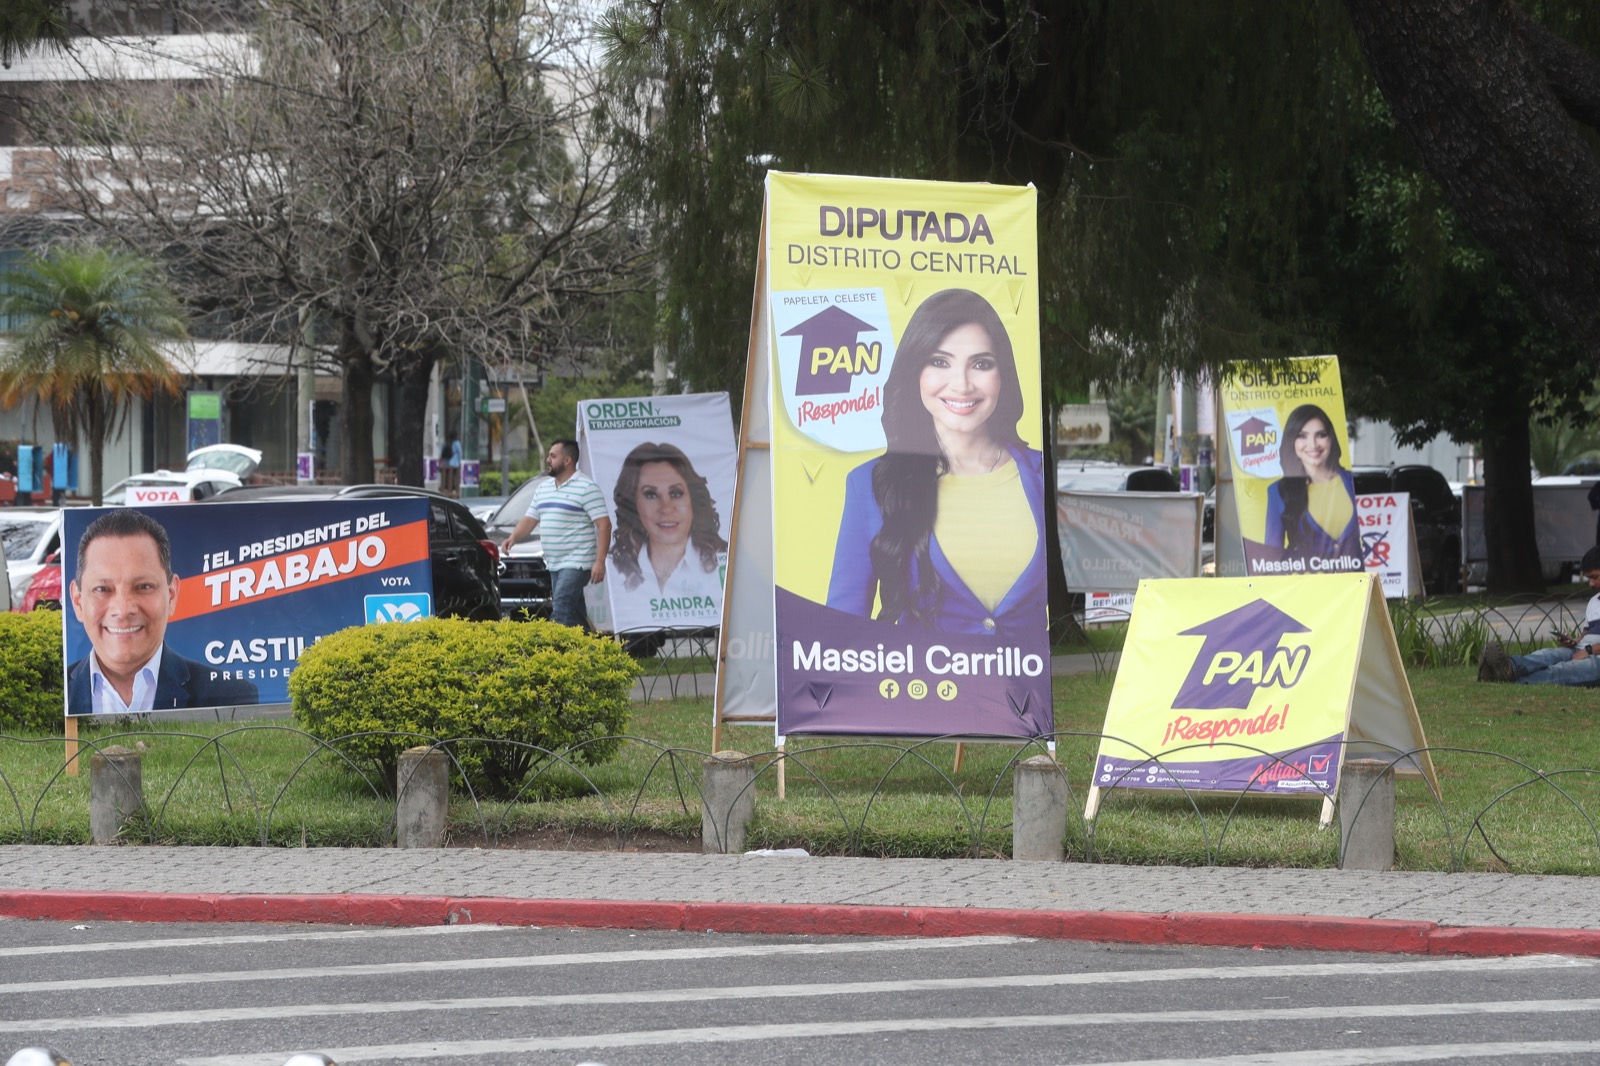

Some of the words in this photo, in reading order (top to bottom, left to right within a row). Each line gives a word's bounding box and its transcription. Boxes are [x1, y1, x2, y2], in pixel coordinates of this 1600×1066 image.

[820, 205, 994, 245] DIPUTADA
[788, 244, 901, 270] DISTRITO
[910, 250, 1027, 276] CENTRAL
[784, 296, 829, 306] PAPELETA
[835, 293, 877, 303] CELESTE
[810, 344, 880, 376] PAN
[1230, 390, 1280, 401] DISTRITO
[1284, 387, 1337, 399] CENTRAL
[587, 401, 653, 419] ORDEN
[654, 408, 661, 416] Y
[798, 386, 880, 427] ¡Responde!
[591, 416, 678, 429] TRANSFORMACIÓN
[1245, 431, 1277, 448] PAN
[136, 491, 179, 501] VOTA
[203, 551, 234, 572] ¡EL
[239, 520, 351, 562] PRESIDENTE
[356, 512, 390, 533] DEL
[204, 536, 386, 607] TRABAJO
[1252, 558, 1305, 573] Massiel
[1310, 555, 1362, 571] Carrillo
[381, 577, 411, 586] VOTA
[1382, 578, 1402, 586] ANO
[650, 596, 715, 612] SANDRA
[1093, 596, 1135, 607] REPUBLI
[652, 609, 718, 619] PRESIDENTA
[205, 636, 321, 665] CASTIL
[792, 640, 914, 673] Massiel
[925, 645, 1044, 677] Carrillo
[210, 668, 290, 681] PRESIDE
[1202, 645, 1310, 688] PAN
[1161, 704, 1290, 749] ¡Responde!
